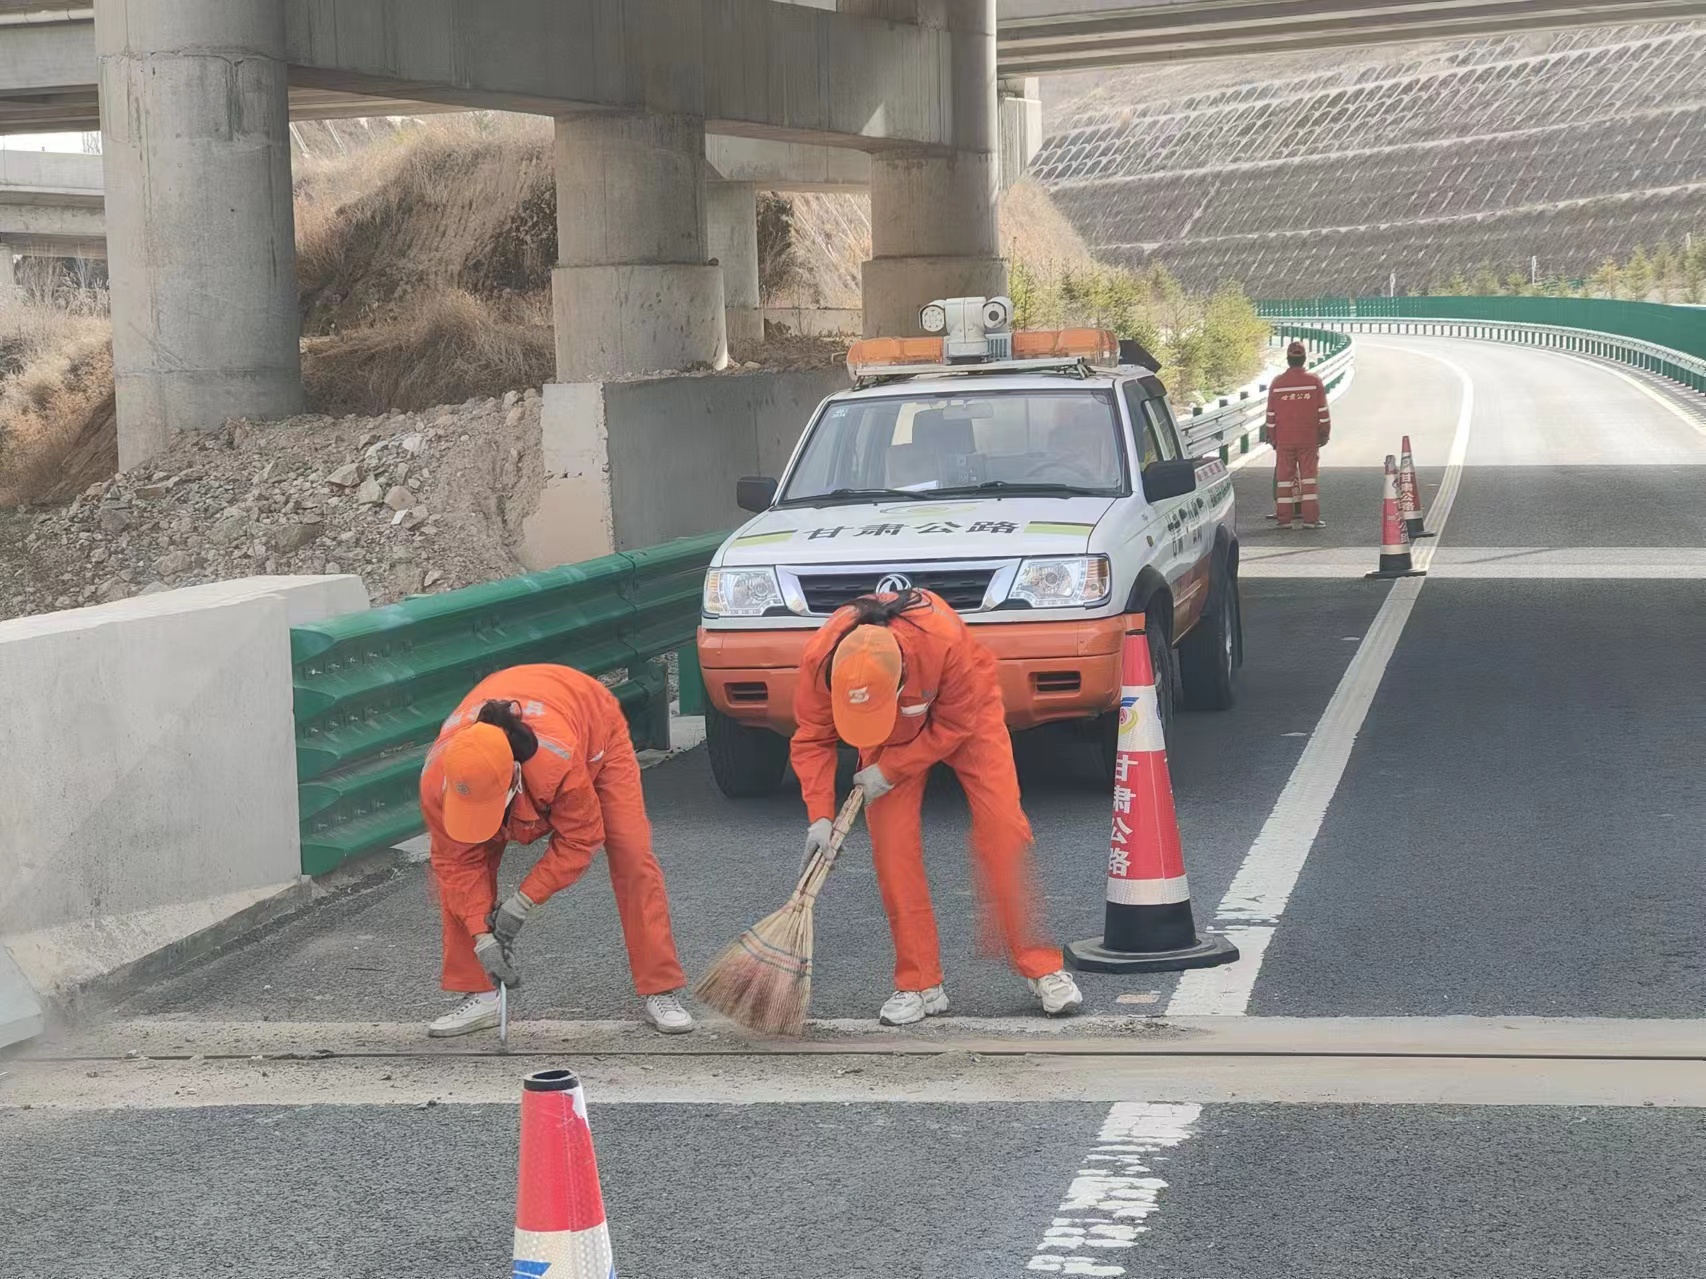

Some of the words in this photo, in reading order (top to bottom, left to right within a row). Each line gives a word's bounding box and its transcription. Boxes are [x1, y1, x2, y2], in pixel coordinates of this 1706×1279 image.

[1400, 473, 1415, 512] 甘肃公路
[803, 520, 1021, 540] 甘肃公路
